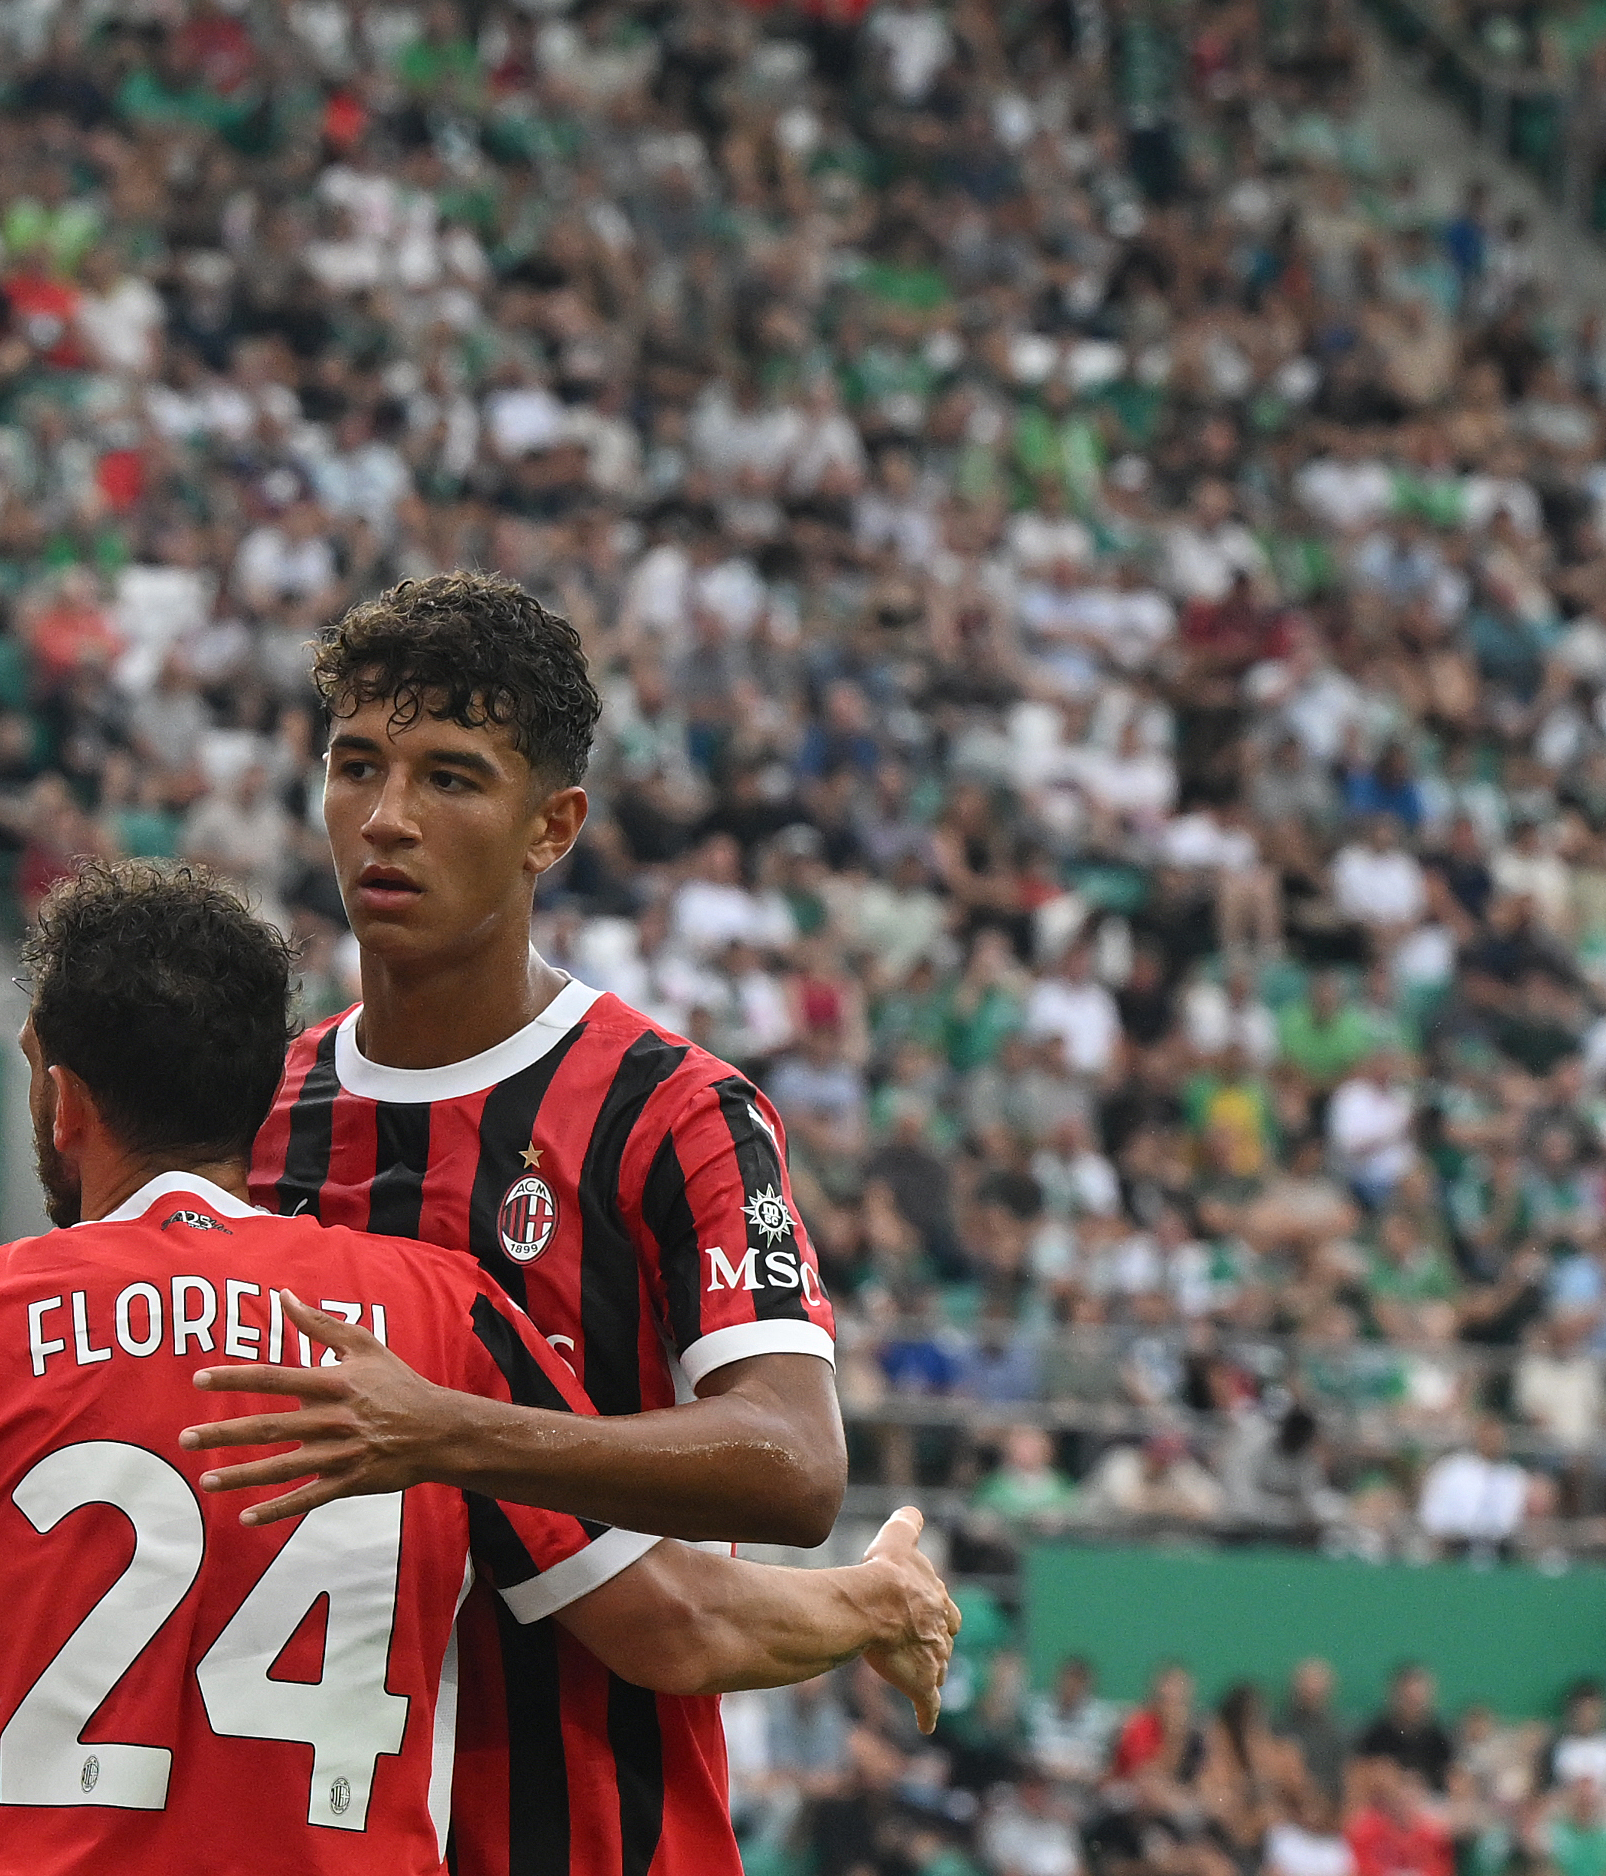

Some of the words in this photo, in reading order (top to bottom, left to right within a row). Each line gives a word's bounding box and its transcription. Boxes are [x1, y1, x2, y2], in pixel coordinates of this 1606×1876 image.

[514, 1181, 546, 1197] ACM
[510, 1244, 538, 1254] 1899
[705, 1246, 821, 1306] MSC
[27, 1275, 387, 1376] FLORENZI
